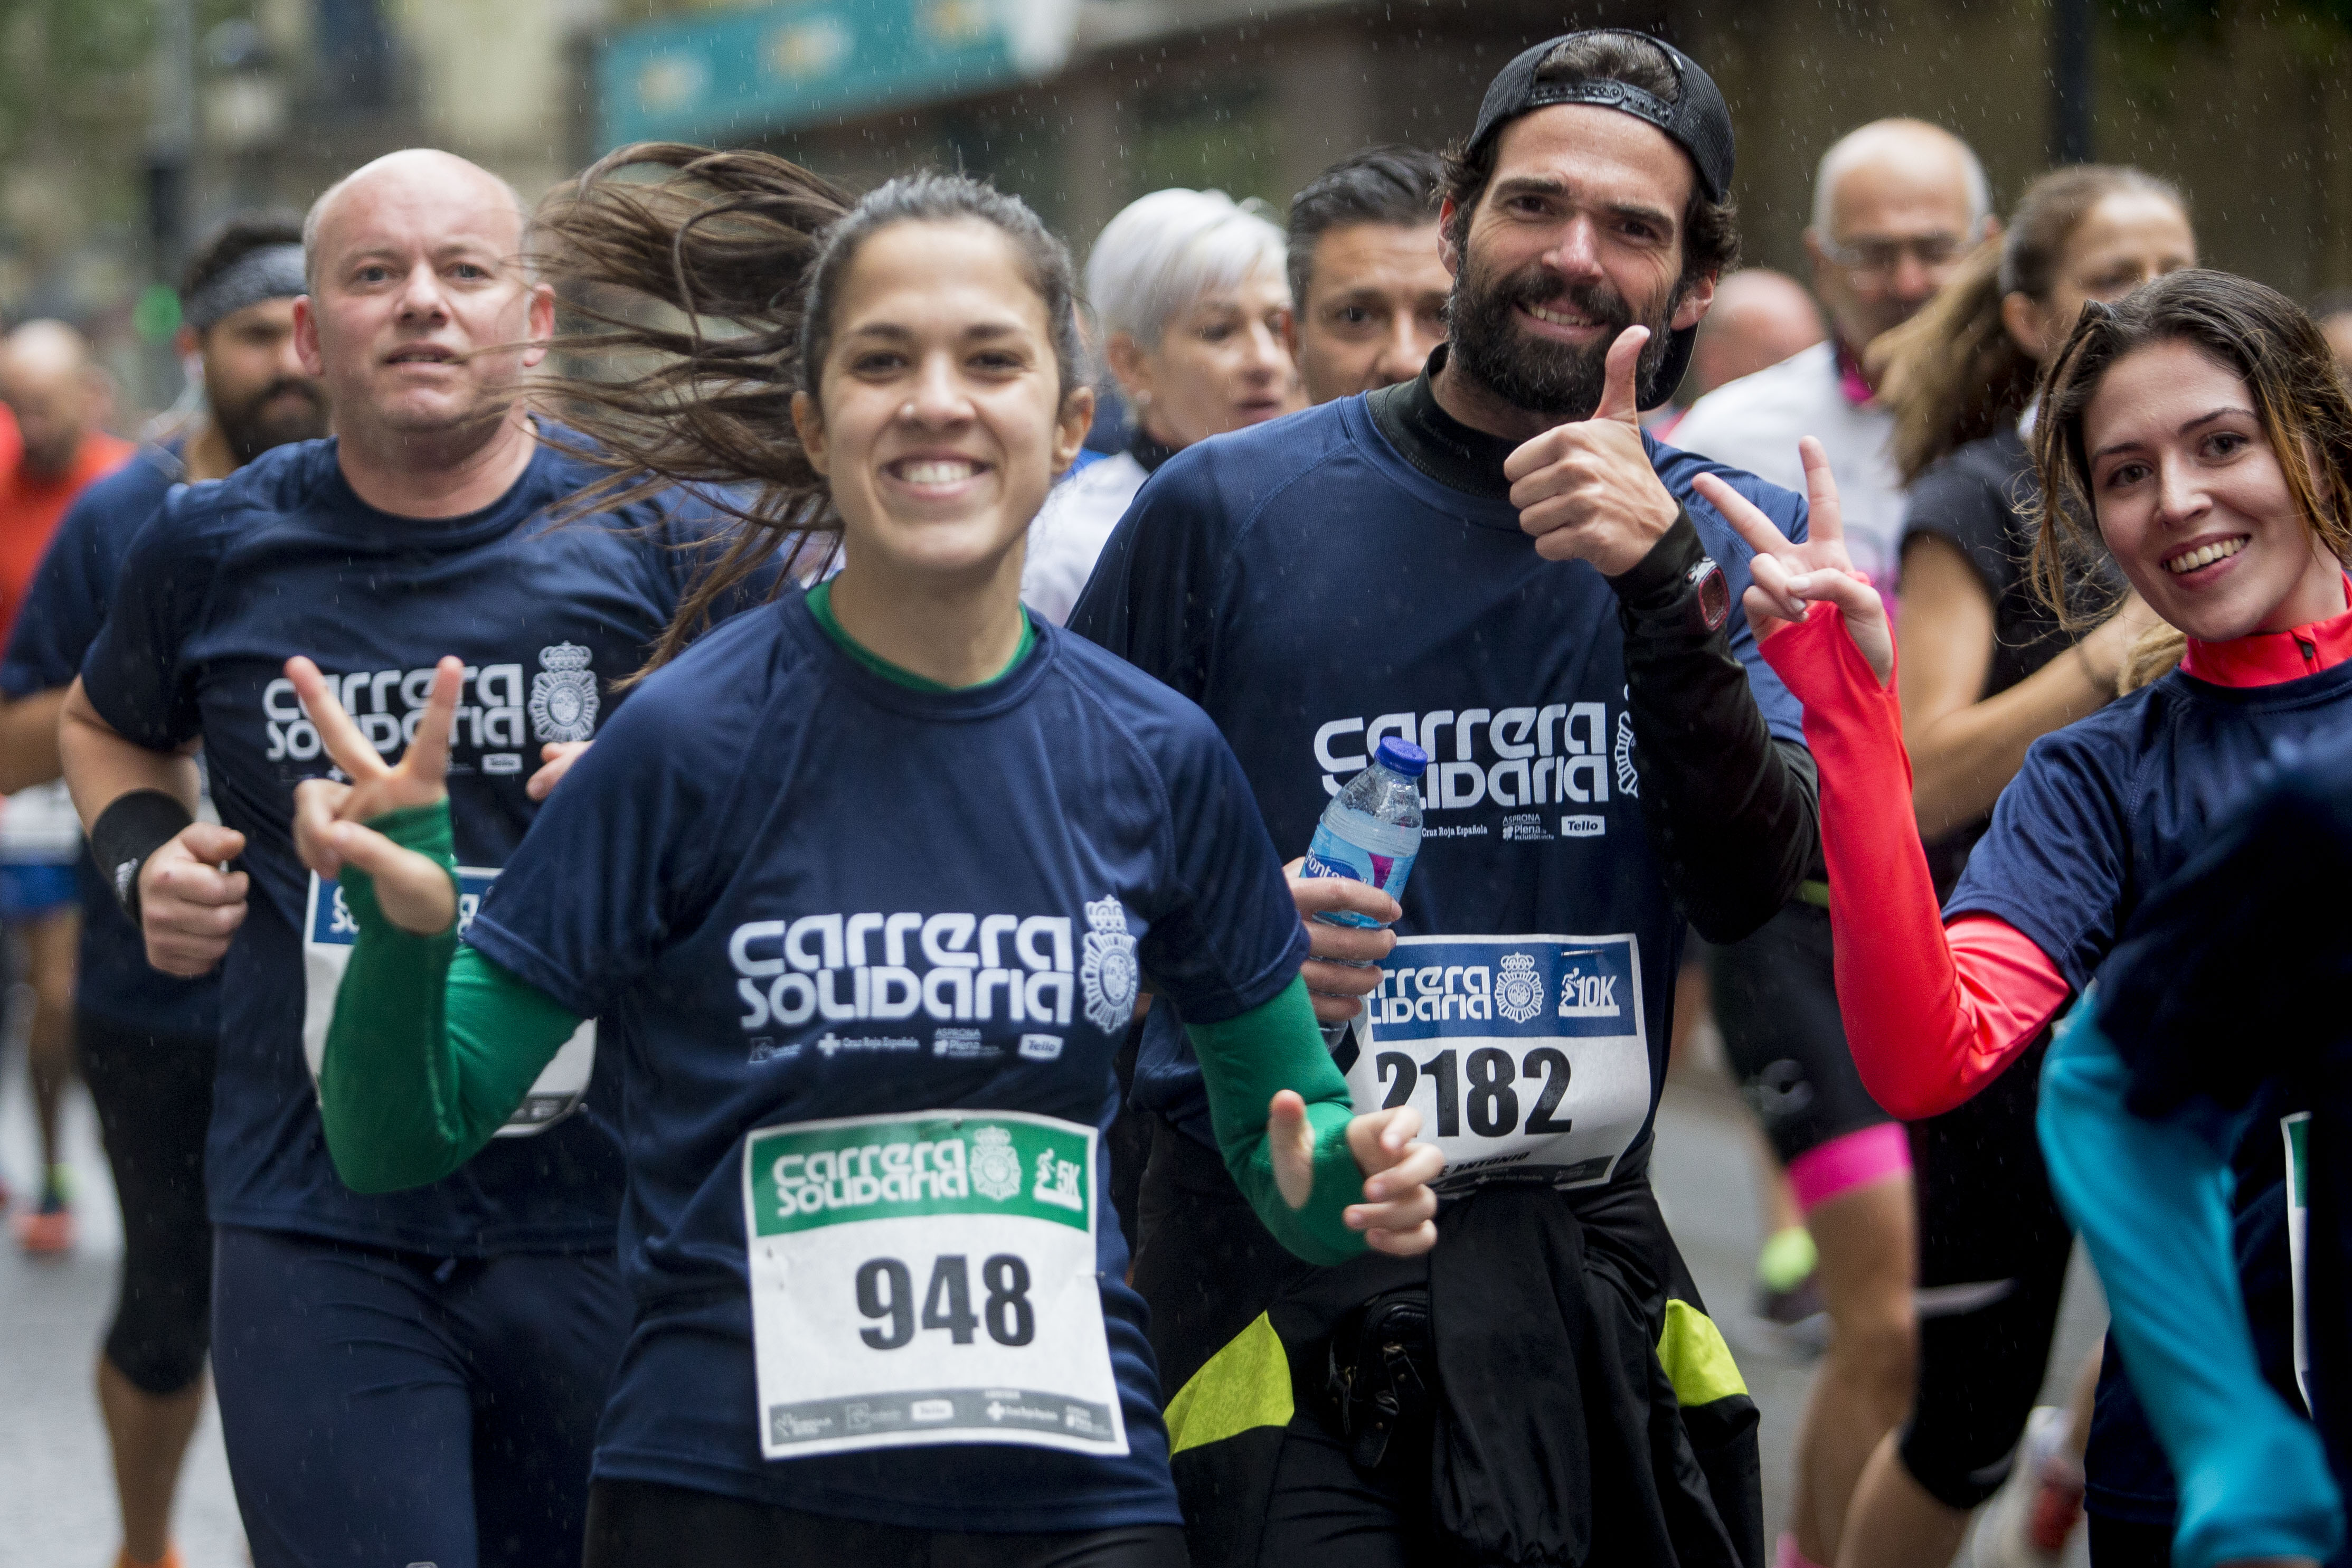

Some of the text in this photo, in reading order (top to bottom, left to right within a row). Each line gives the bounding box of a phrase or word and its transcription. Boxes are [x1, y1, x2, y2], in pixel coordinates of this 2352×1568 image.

[1503, 814, 1541, 825] ASPRONA
[1567, 820, 1599, 832] Tello
[1422, 824, 1488, 838] Cruz Roja Española
[1515, 824, 1541, 834] Plena
[1579, 976, 1617, 1007] 10K
[1376, 1047, 1573, 1138] 2182
[855, 1253, 1035, 1350] 948
